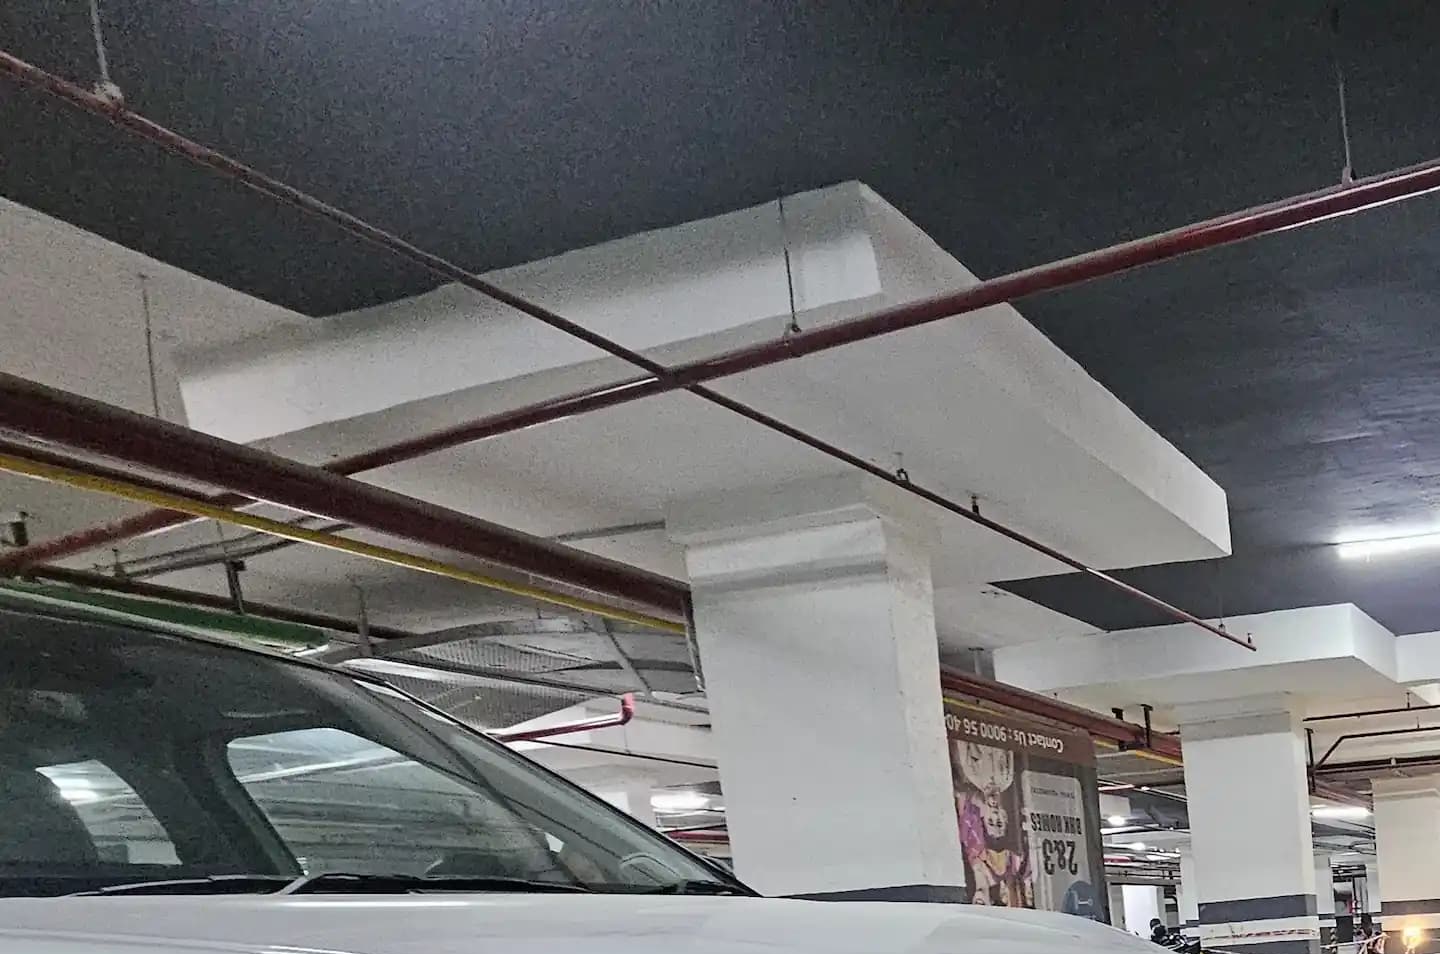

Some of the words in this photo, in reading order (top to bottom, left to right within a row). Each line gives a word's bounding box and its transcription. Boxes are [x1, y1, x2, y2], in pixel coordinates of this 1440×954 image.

[945, 713, 961, 731] 40
[963, 718, 977, 736] 56
[980, 723, 1007, 742] 9000
[1014, 729, 1027, 746] Us
[1028, 733, 1064, 753] Contact
[1030, 812, 1062, 832] HOMES
[1064, 816, 1082, 835] BHK
[1042, 838, 1078, 876] 2&3
